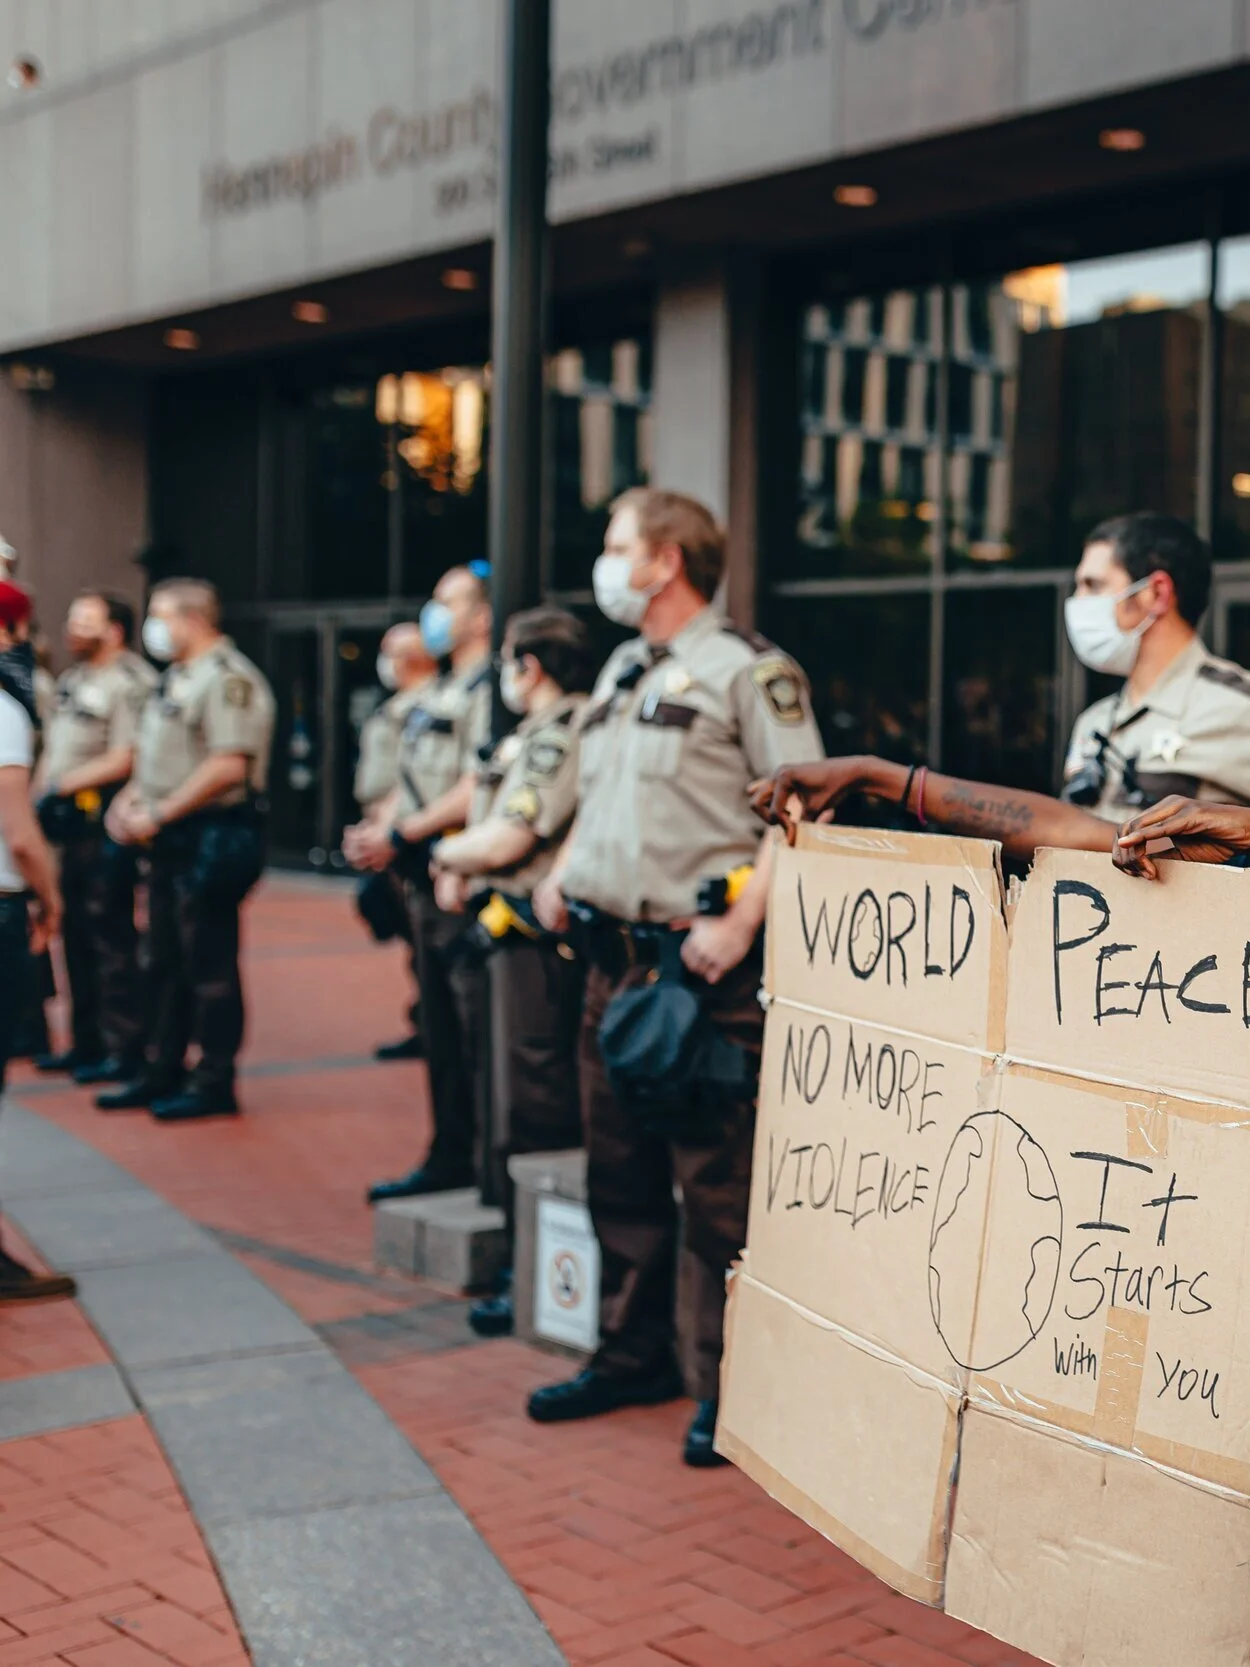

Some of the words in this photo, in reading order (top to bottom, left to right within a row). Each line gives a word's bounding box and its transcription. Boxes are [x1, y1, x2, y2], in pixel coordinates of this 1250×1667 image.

[797, 873, 976, 988] WORLD
[780, 1023, 832, 1106] NO
[842, 1023, 946, 1134] MORE
[765, 1133, 931, 1231] VIOLENCE
[1064, 1241, 1213, 1321] Starts
